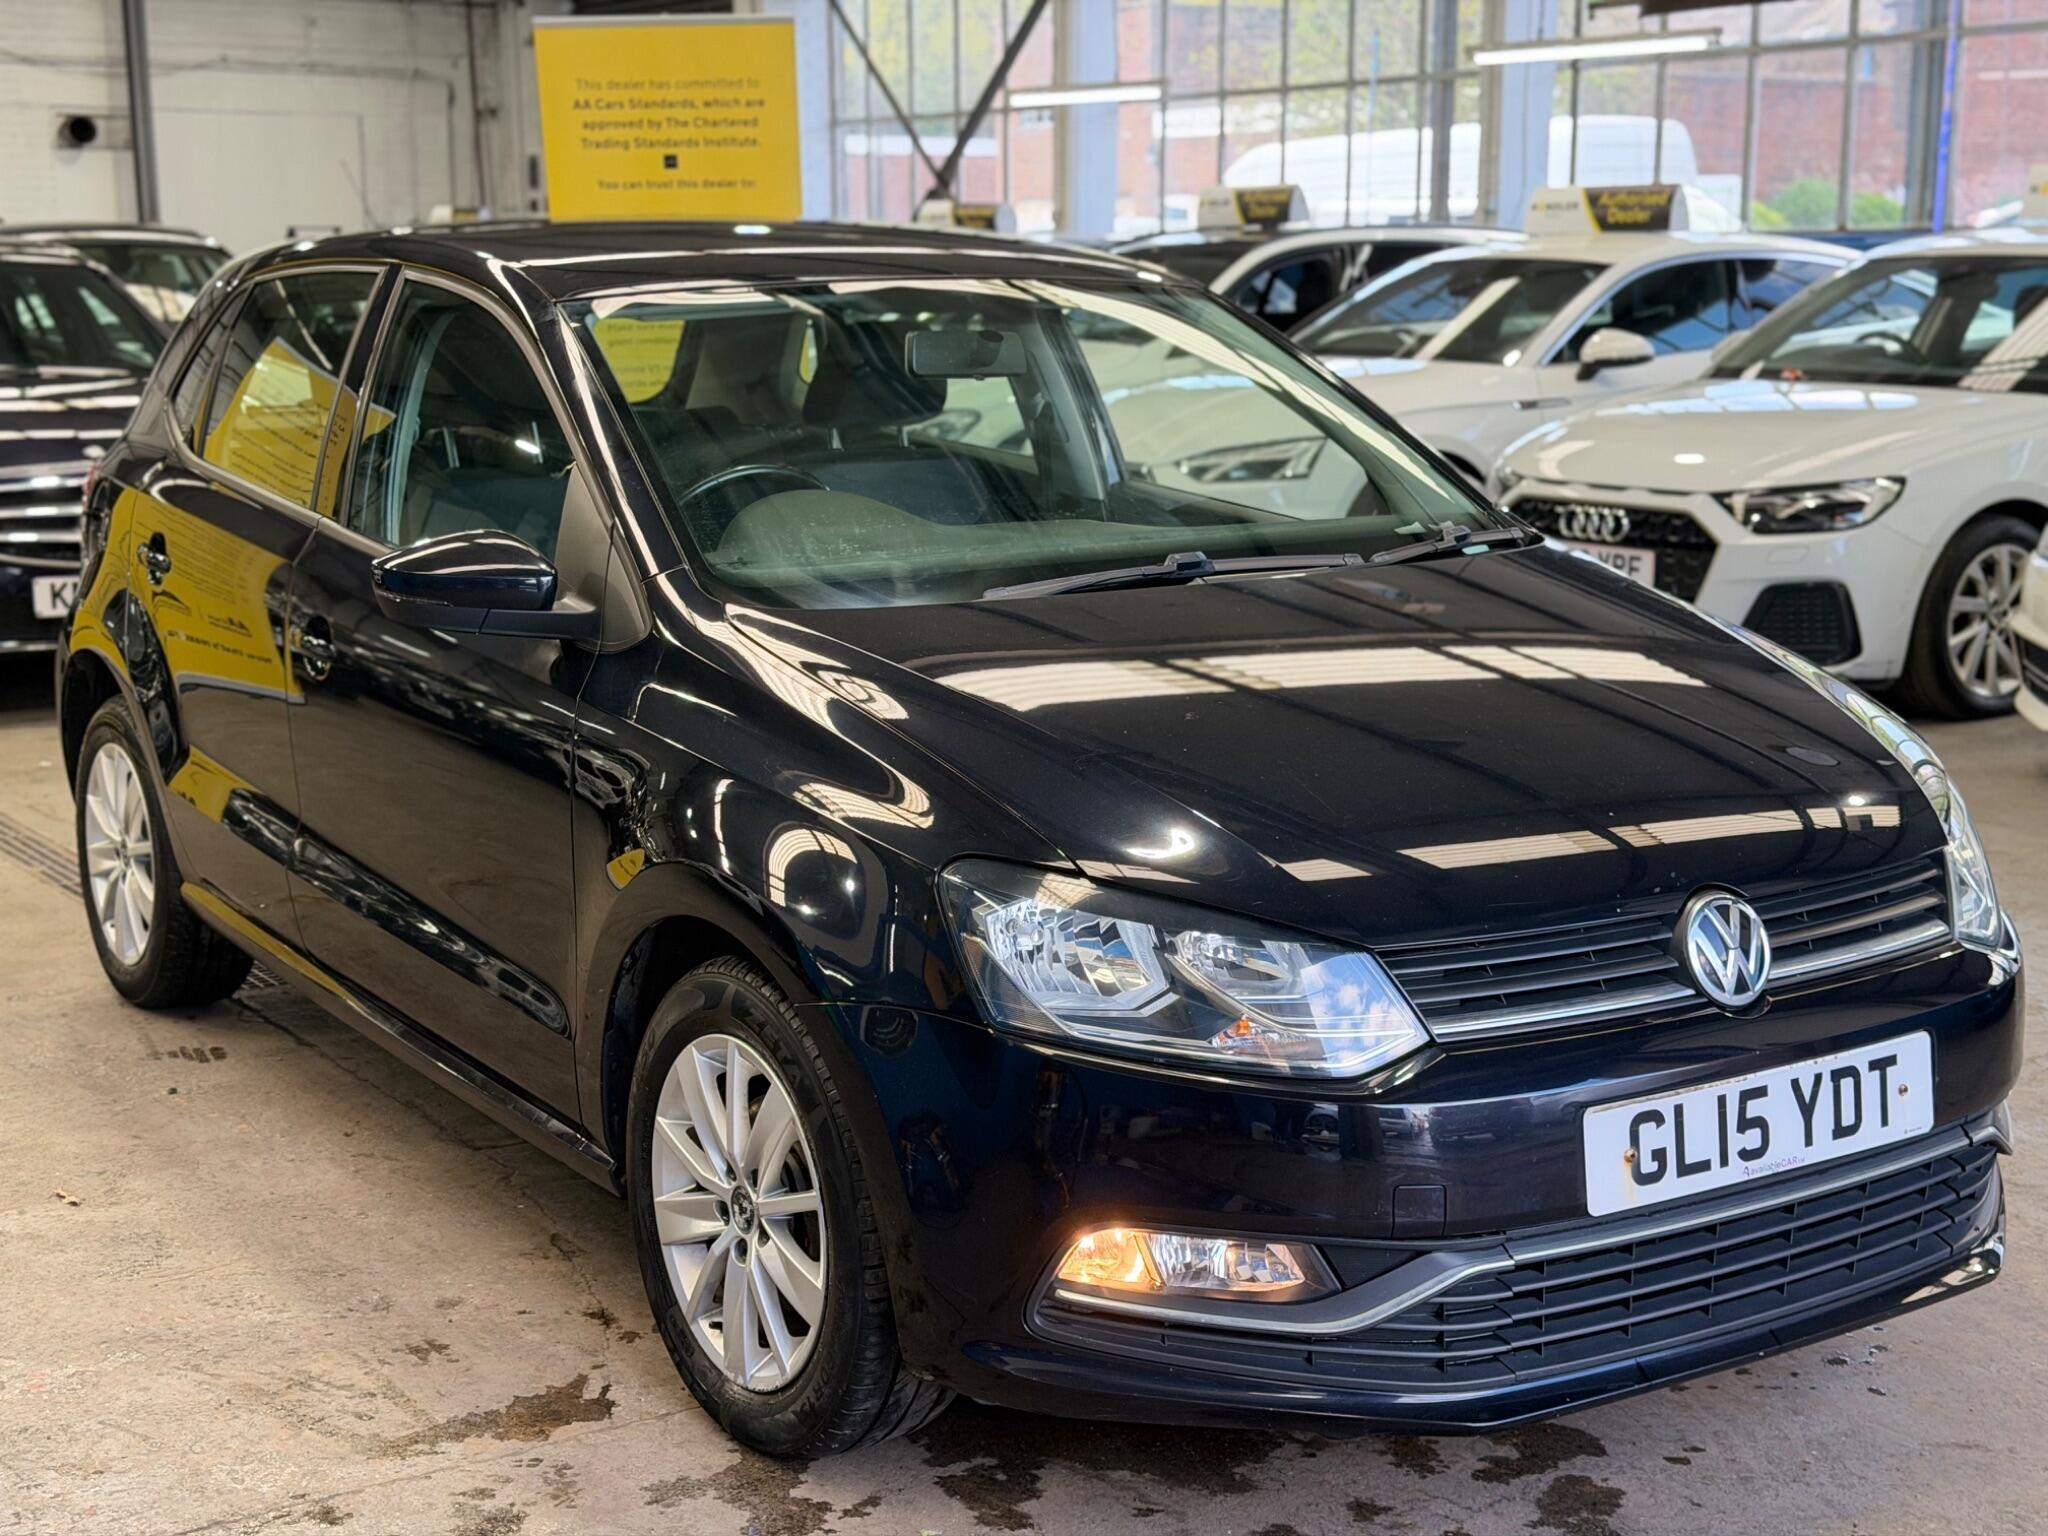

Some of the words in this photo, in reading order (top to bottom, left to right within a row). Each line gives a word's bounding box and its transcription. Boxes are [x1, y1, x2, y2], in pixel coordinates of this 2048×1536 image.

[576, 78, 602, 91] This
[606, 77, 646, 91] dealer
[648, 77, 670, 90] has
[675, 77, 743, 90] committed
[746, 76, 760, 89] to
[572, 98, 592, 111] AA
[595, 97, 625, 110] Cars
[702, 96, 741, 109] which
[744, 98, 766, 108] are
[581, 118, 644, 132] approved
[647, 117, 663, 132] by
[665, 117, 690, 129] The
[692, 116, 759, 129] Chartered
[580, 138, 630, 152] Trading
[633, 137, 700, 150] Standards
[597, 179, 619, 191] You
[621, 181, 643, 191] can
[645, 179, 674, 190] trust
[676, 178, 700, 190] this
[701, 178, 738, 190] dealer
[50, 582, 79, 610] K
[1629, 1084, 1770, 1187] GL15
[1790, 1053, 1899, 1149] YDT
